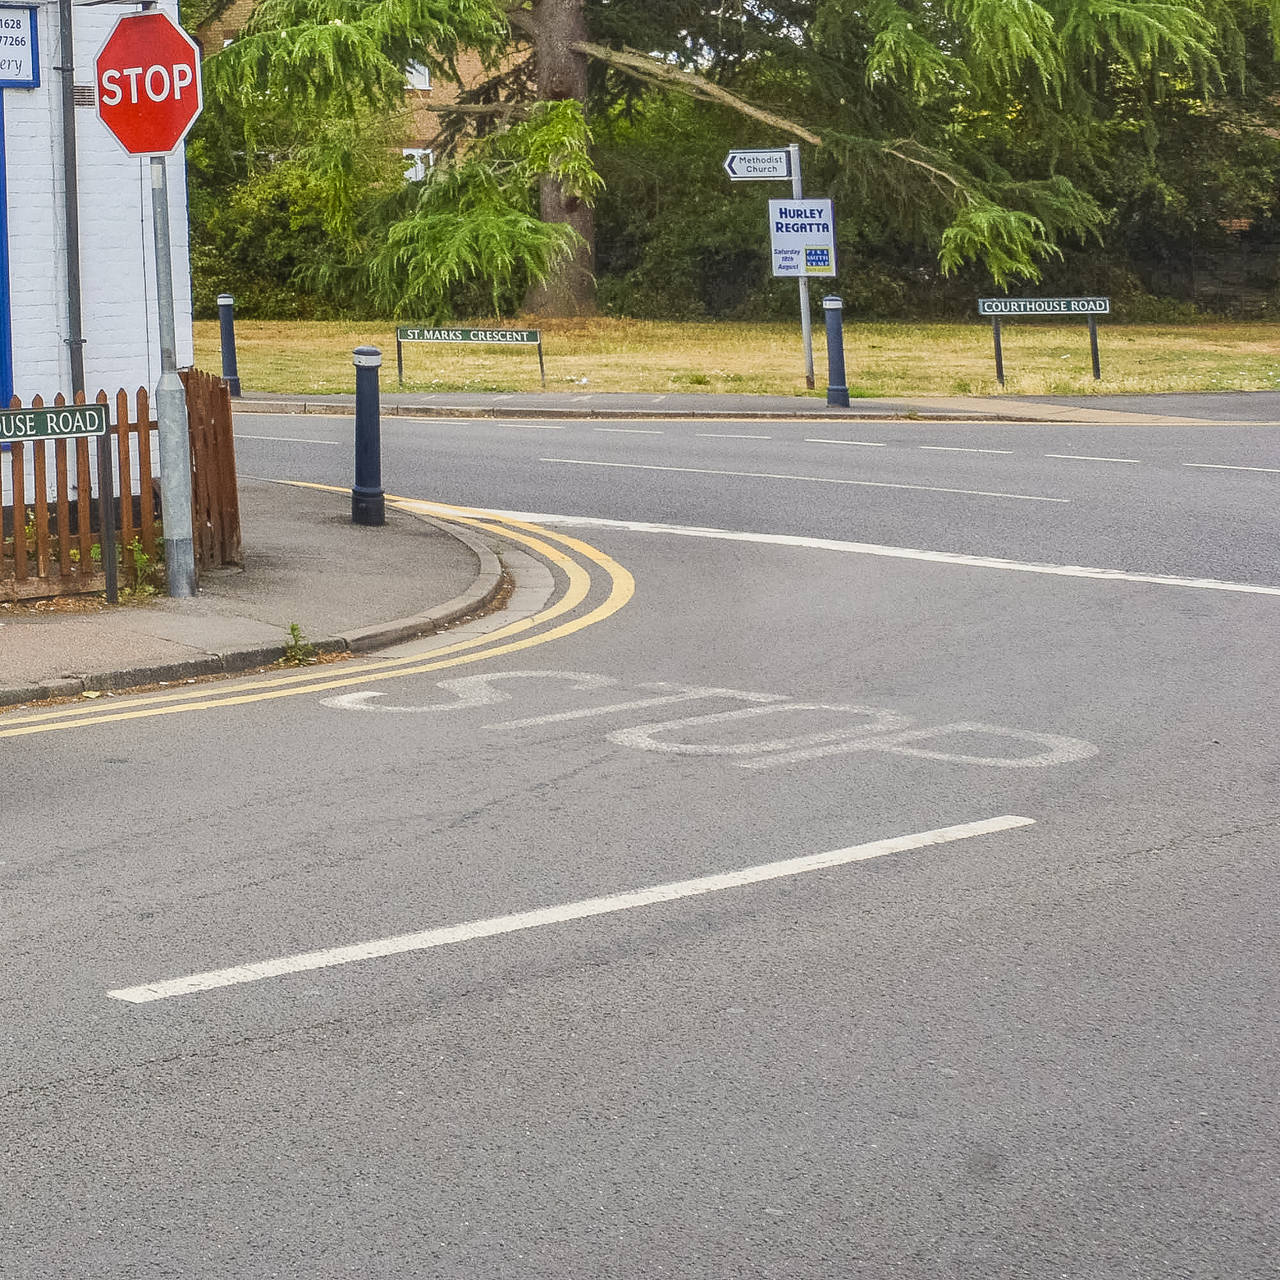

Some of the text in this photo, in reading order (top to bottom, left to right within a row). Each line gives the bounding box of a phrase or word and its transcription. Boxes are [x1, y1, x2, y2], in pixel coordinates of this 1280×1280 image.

[101, 63, 193, 106] STOP
[739, 156, 783, 164] Methodist
[779, 207, 824, 219] HURLEY
[775, 222, 830, 233] REGATTA
[984, 300, 1105, 312] COURTHOUSE ROAD
[470, 331, 529, 342] CRESCENT
[46, 410, 100, 433] ROAD
[319, 670, 1098, 770] STOP
